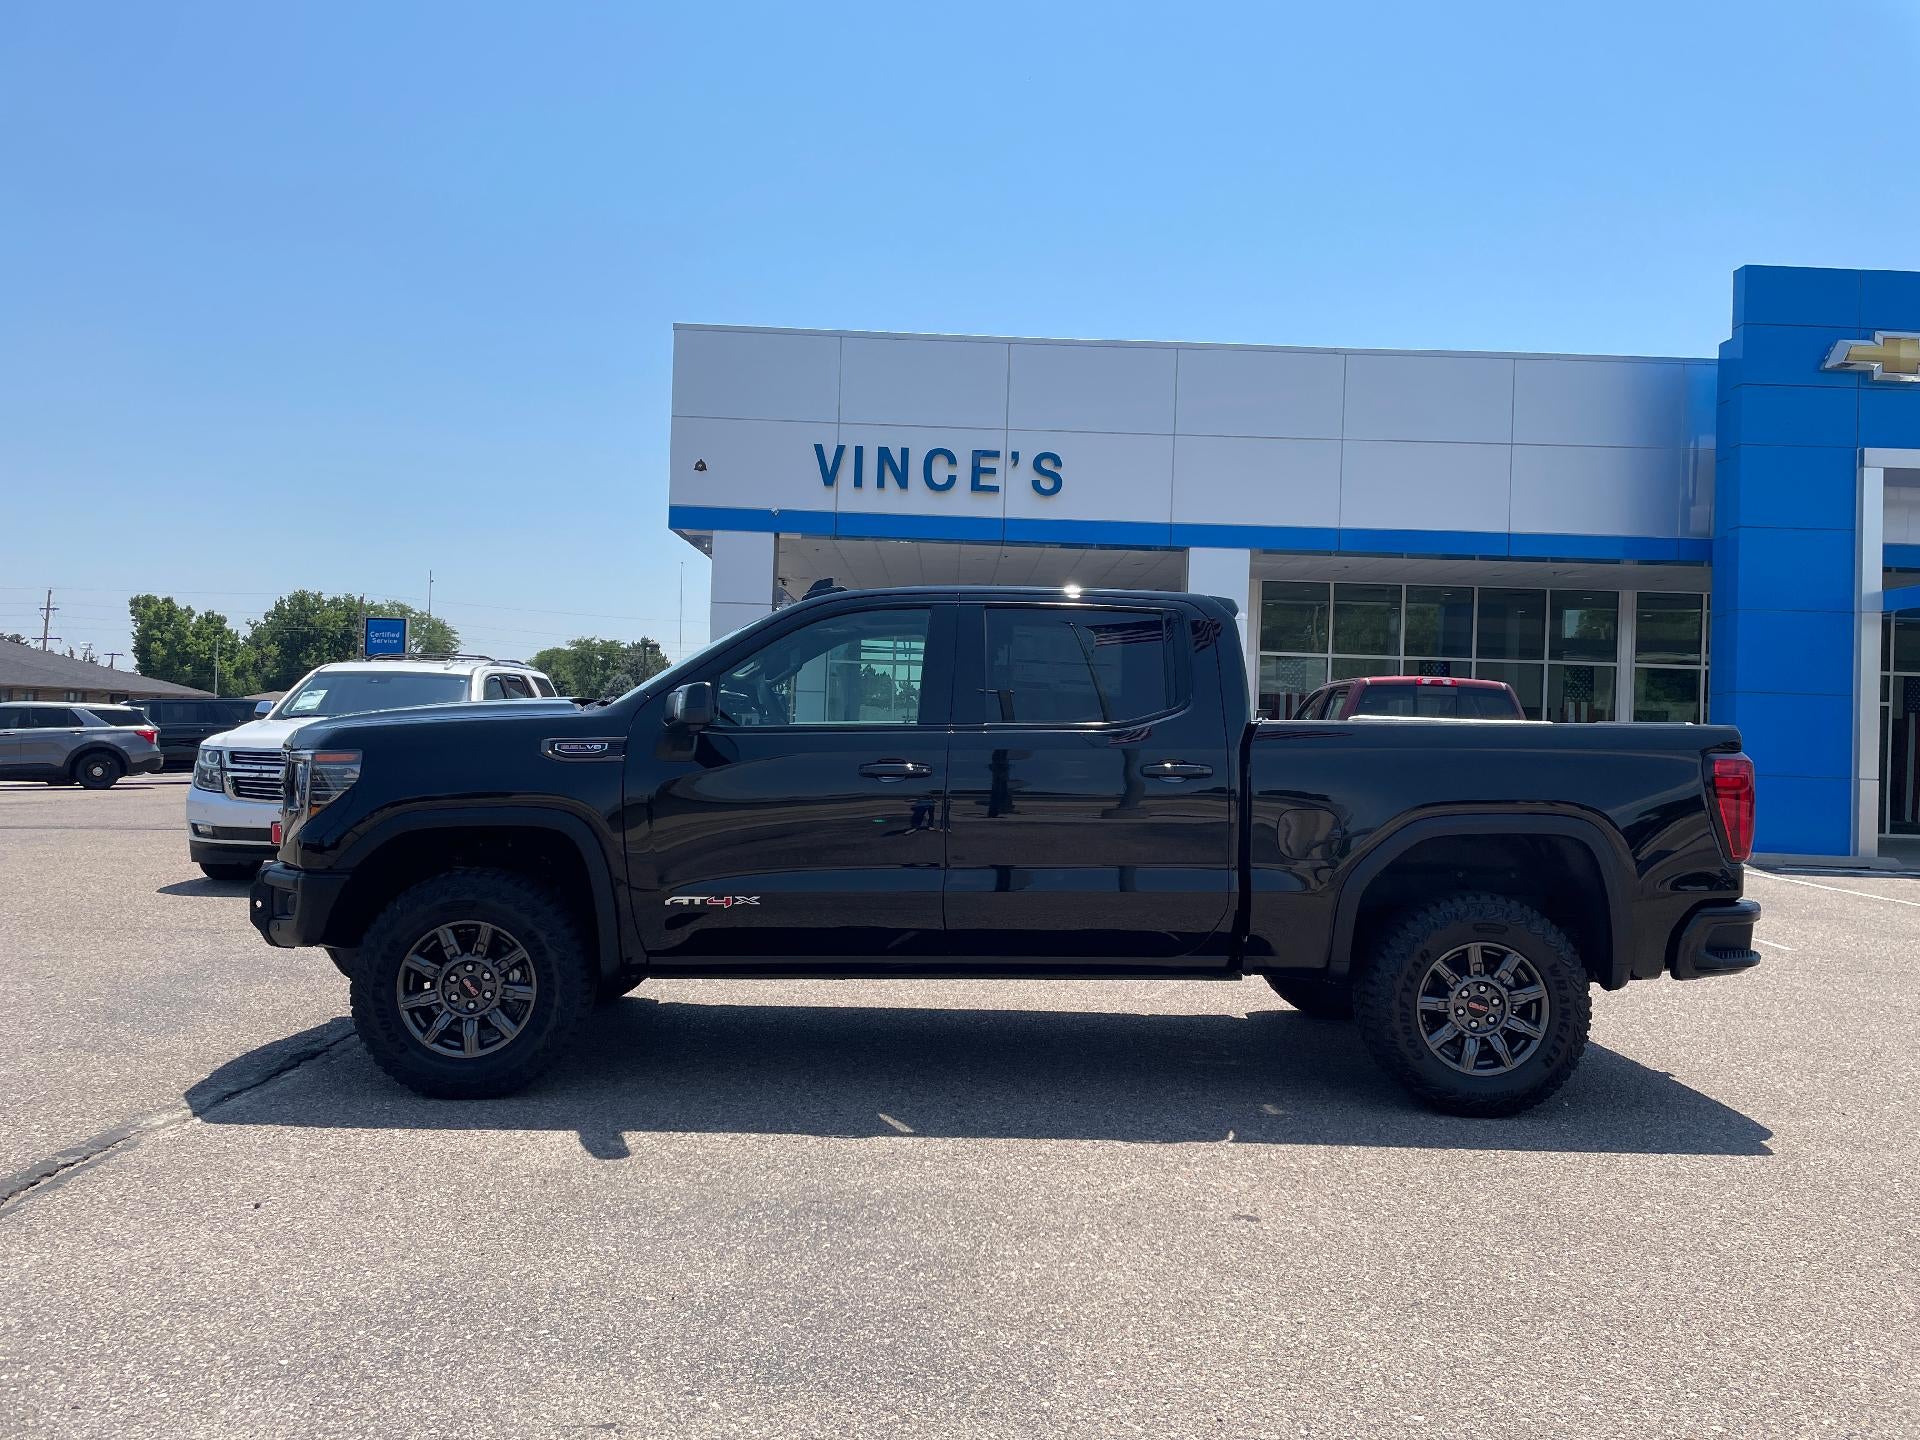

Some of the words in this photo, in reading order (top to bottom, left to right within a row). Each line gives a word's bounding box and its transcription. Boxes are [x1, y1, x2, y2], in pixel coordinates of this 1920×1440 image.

[813, 443, 1063, 496] VINCE'S
[369, 631, 400, 639] Certified
[664, 896, 761, 909] AT4X
